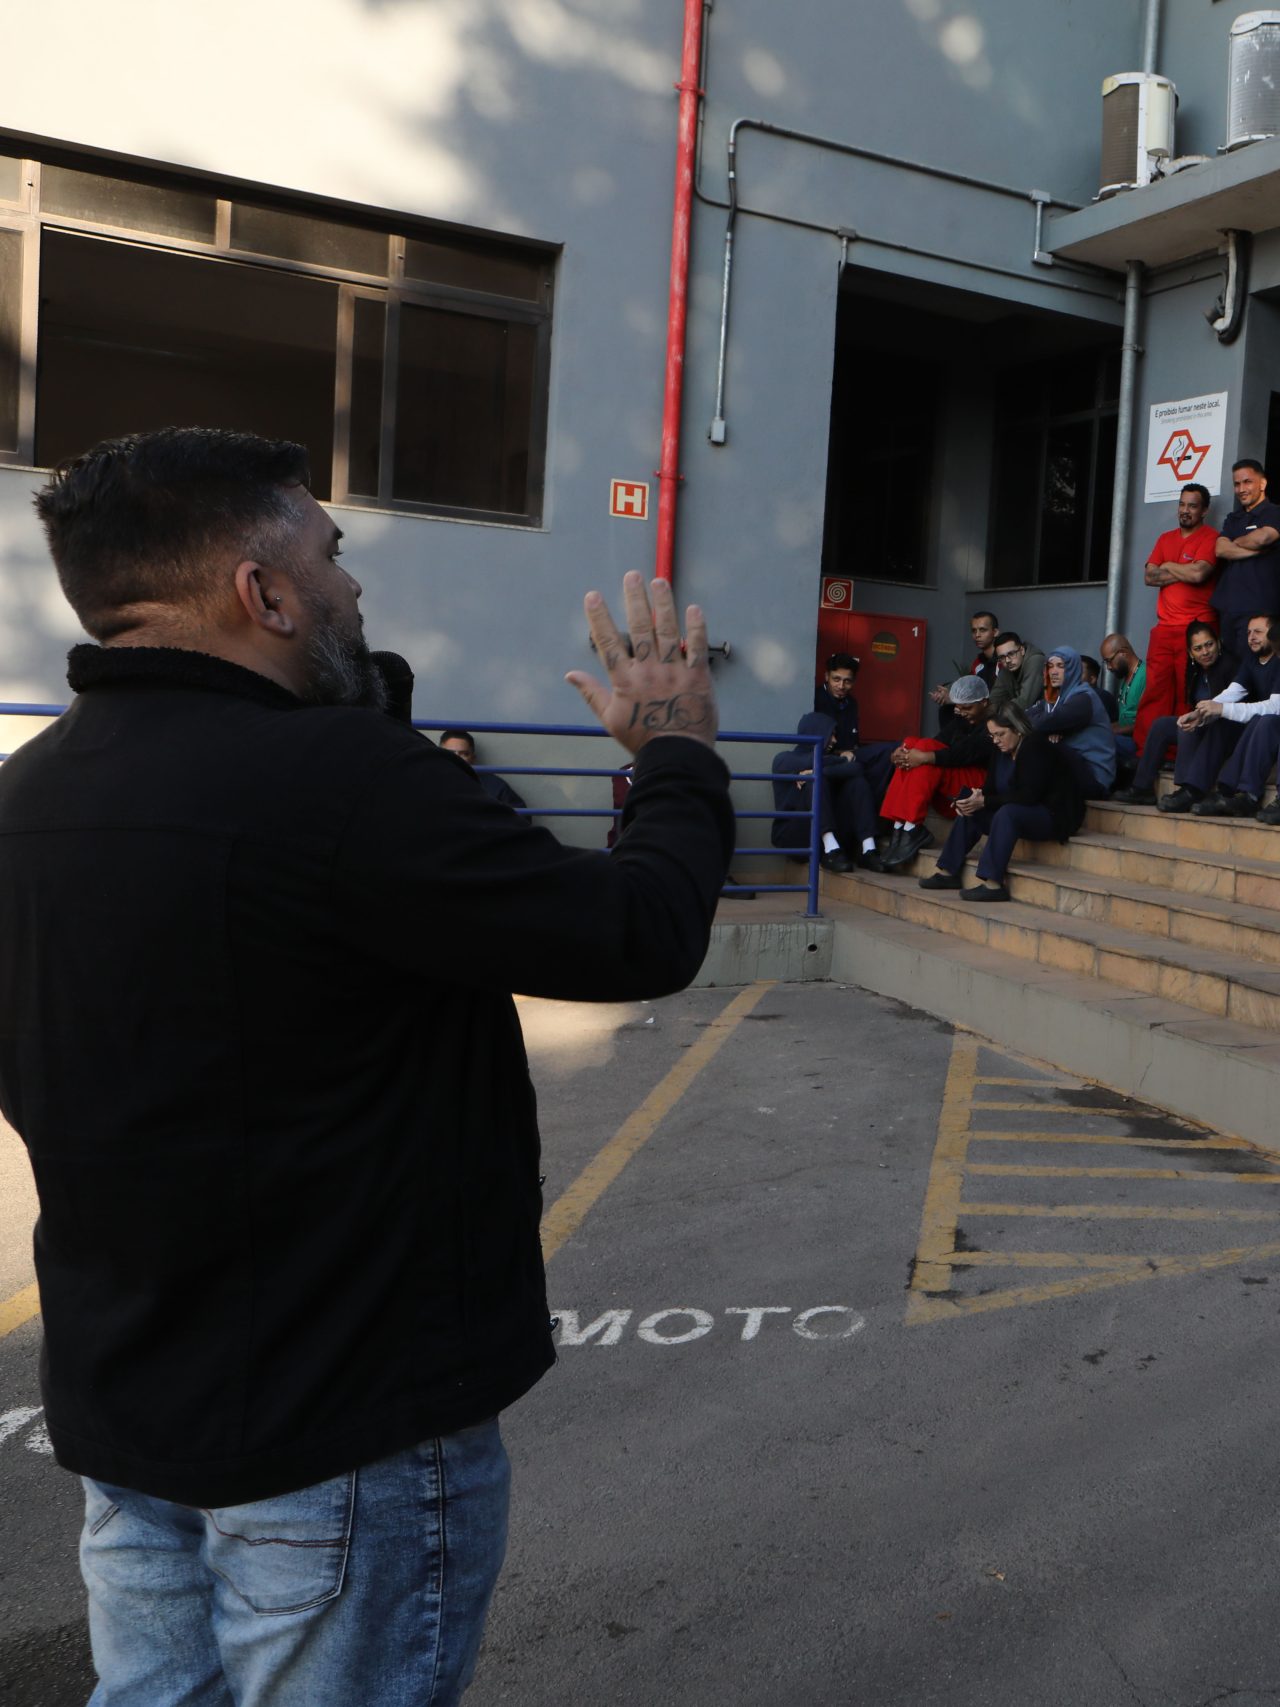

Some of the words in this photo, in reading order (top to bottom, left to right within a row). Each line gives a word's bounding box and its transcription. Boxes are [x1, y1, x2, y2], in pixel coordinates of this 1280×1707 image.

[1159, 406, 1177, 418] proibido
[1178, 405, 1192, 414] fumar
[1193, 403, 1207, 411] neste
[616, 485, 642, 514] H
[912, 626, 919, 637] 1
[550, 1305, 865, 1346] MOTO
